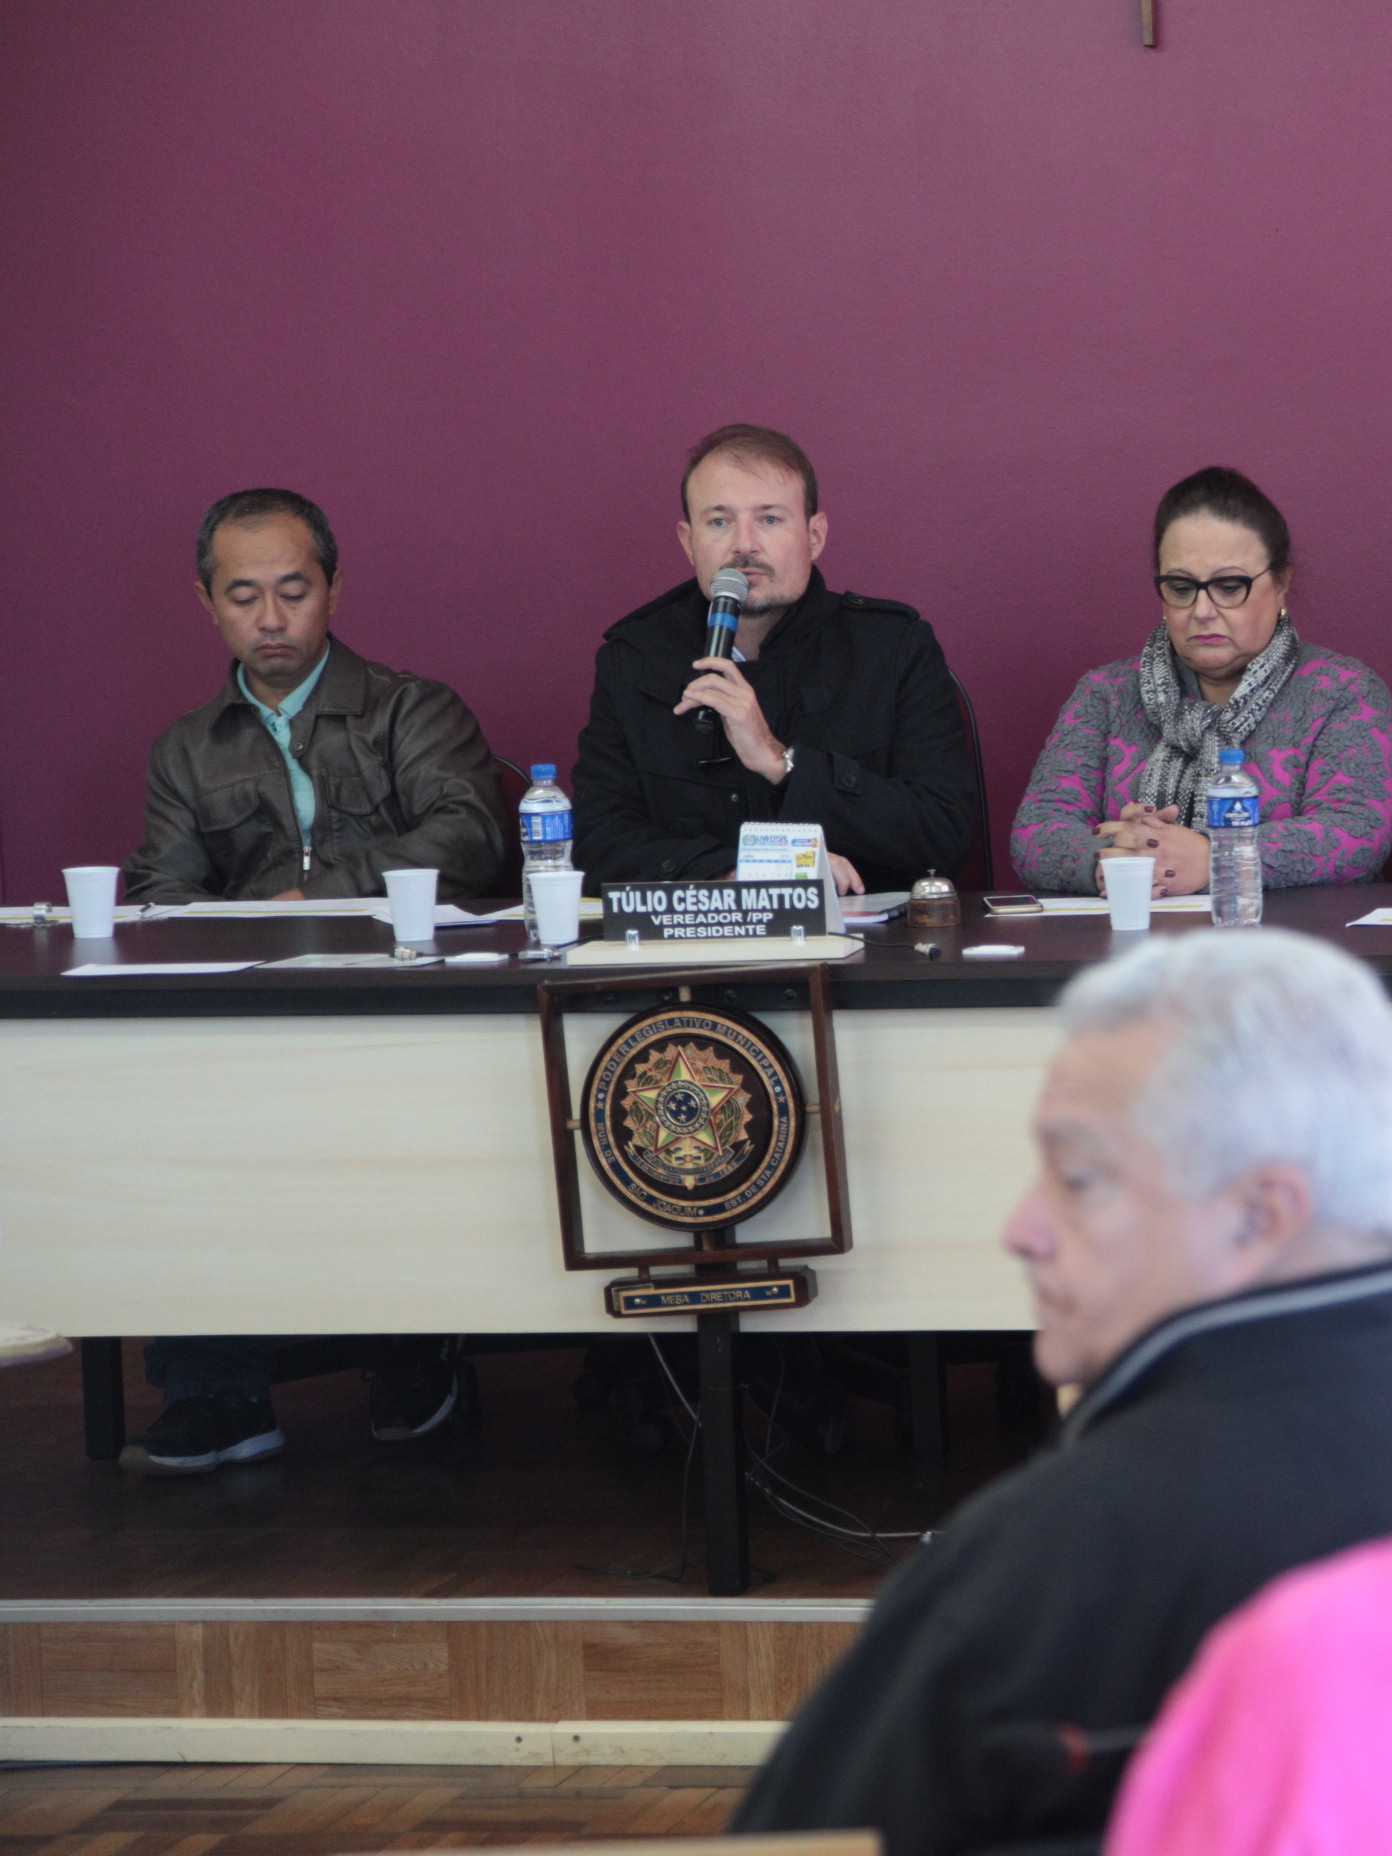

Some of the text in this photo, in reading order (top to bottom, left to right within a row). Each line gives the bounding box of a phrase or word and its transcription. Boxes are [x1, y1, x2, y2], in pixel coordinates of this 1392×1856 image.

[608, 885, 820, 913] TÚLIO CÉSAR MATTOS
[651, 912, 774, 926] VEREADOR /PP
[663, 925, 767, 939] PRESIDENTE
[600, 1017, 778, 1090] PODER LEGISLATIVO MUNICIPAL
[744, 1186, 759, 1198] DE
[771, 1116, 788, 1166] CATARINA
[605, 1150, 616, 1164] DE
[652, 1201, 697, 1216] JOAQUIM
[661, 1290, 751, 1305] MESA DIRETORA
